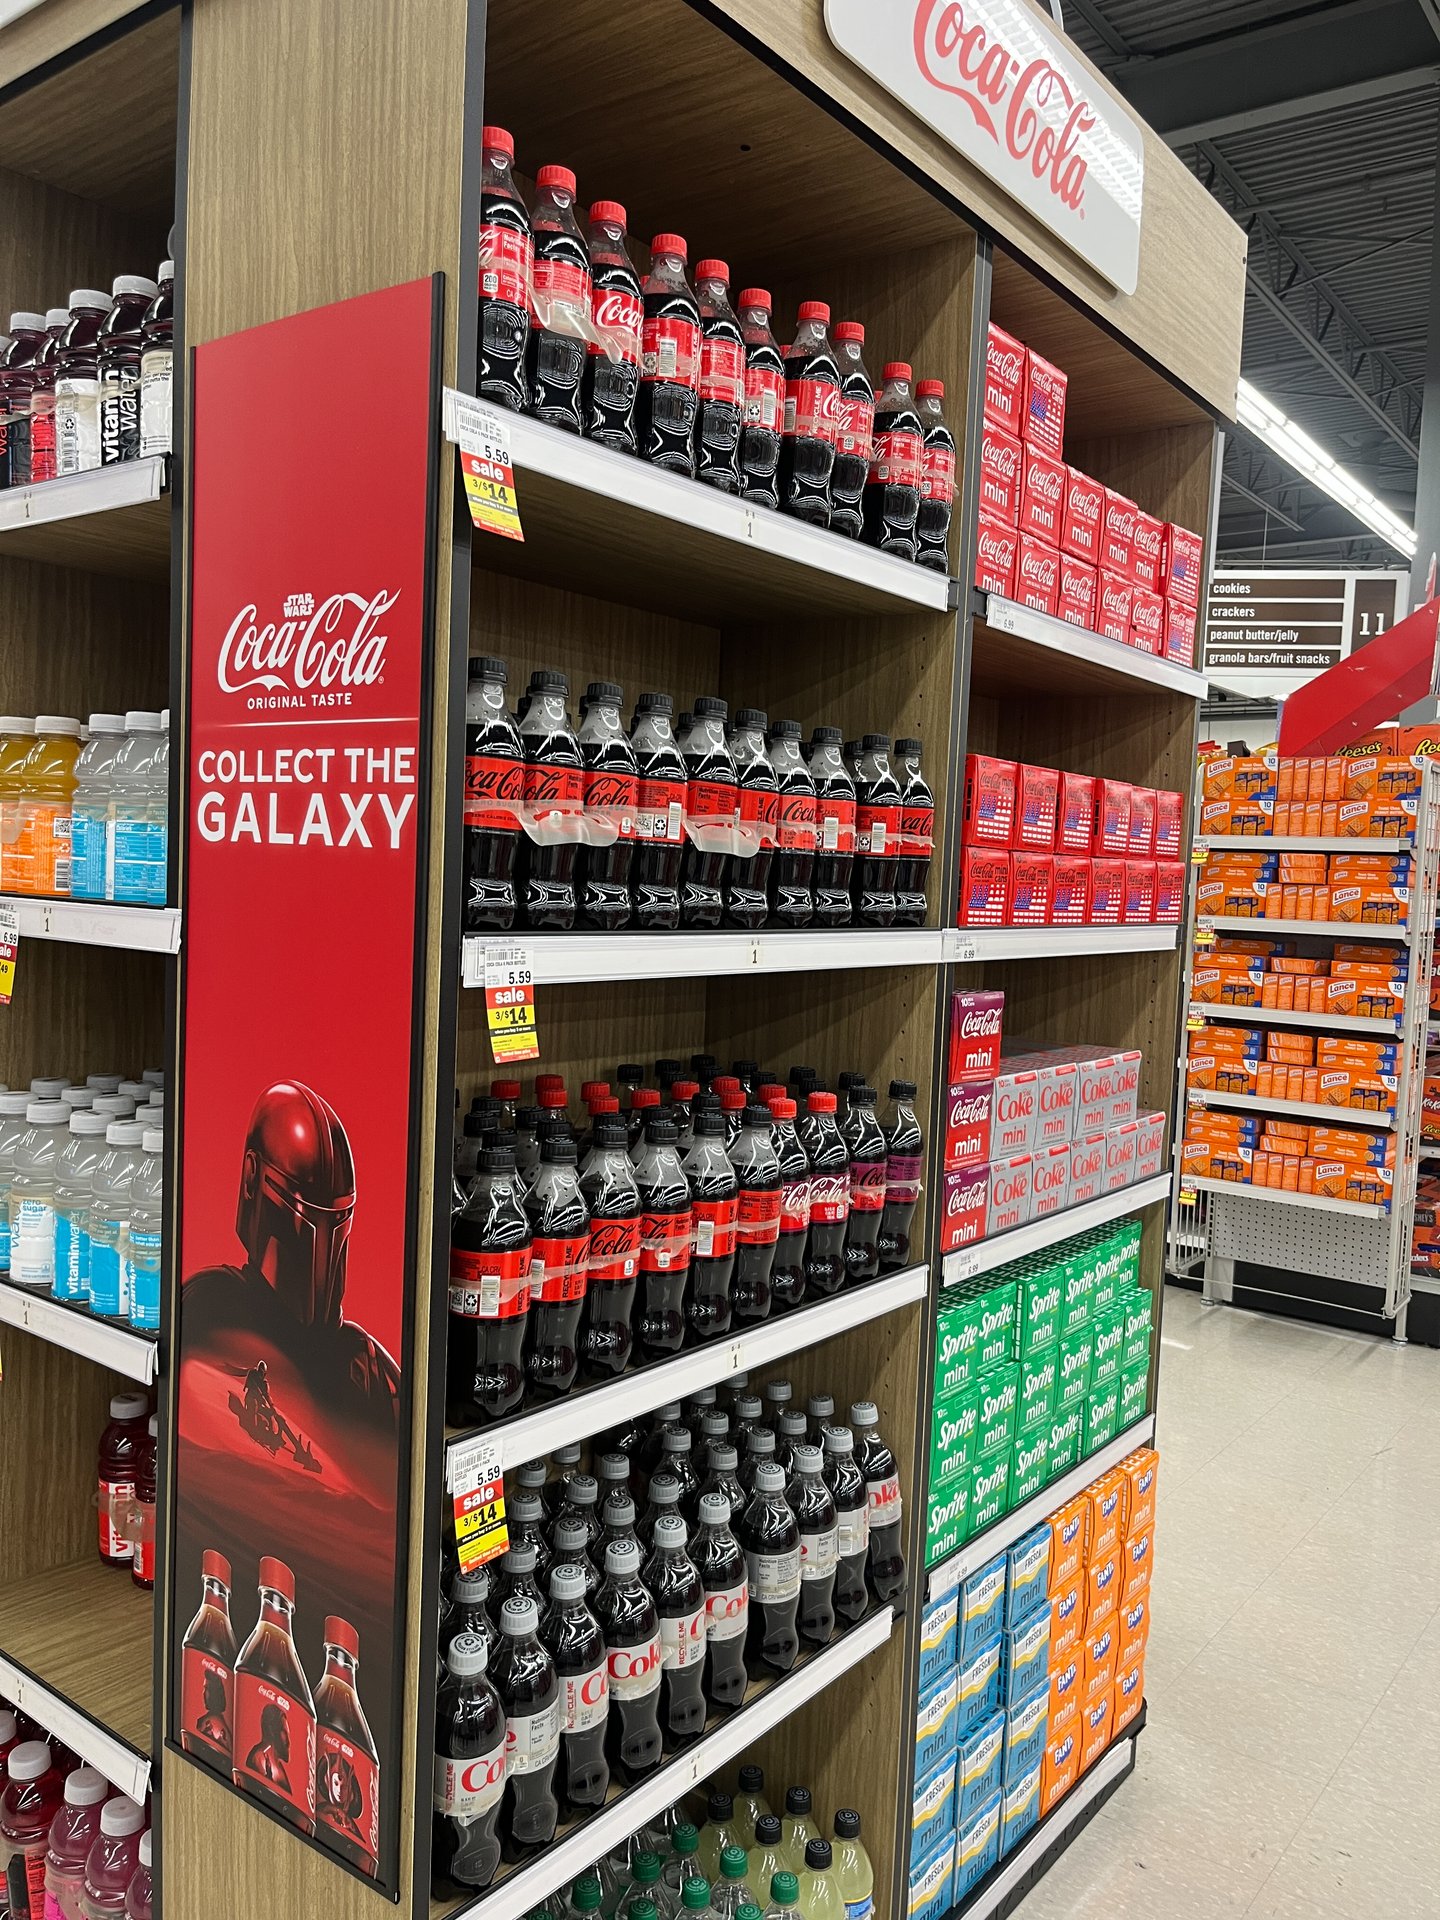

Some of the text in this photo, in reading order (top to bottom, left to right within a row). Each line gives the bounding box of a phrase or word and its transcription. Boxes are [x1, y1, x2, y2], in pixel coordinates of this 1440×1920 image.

[913, 0, 1097, 210] Coca-Cola
[986, 341, 1021, 384] Coca-Cola
[988, 385, 1011, 414] mini
[485, 445, 509, 465] 5.59
[981, 437, 1018, 477] Coca-Cola
[471, 459, 504, 481] sale
[1028, 463, 1063, 500] Coca-Cola
[985, 481, 1008, 507] mini
[1070, 486, 1101, 520] Coca-Cola
[1032, 504, 1054, 529] mini
[1072, 525, 1092, 548] mini
[978, 531, 1014, 568] Coca-Cola
[1109, 543, 1128, 564] mini
[1022, 552, 1057, 586] Coca-Cola
[1136, 559, 1154, 580] mini
[982, 574, 1005, 596] mini
[1062, 570, 1092, 602] Coca-Cola
[1213, 583, 1251, 594] cookies
[284, 604, 314, 618] WARS
[286, 593, 314, 606] STAR
[1026, 592, 1048, 612] mini
[1212, 606, 1255, 617] crackers
[1004, 619, 1014, 629] 6.99
[1210, 629, 1298, 642] peanut butter/jelly
[1360, 613, 1385, 635] 11
[217, 587, 402, 693] Coca-Cola
[1209, 653, 1330, 664] granola bars/fruit snacks
[247, 693, 352, 709] ORIGINAL TASTE
[199, 748, 415, 783] COLLECT THE
[1209, 761, 1232, 772] Lance
[1348, 761, 1375, 773] Lance
[198, 791, 415, 849] GALAXY
[1205, 803, 1228, 815] Lance
[1341, 803, 1367, 816] Lance
[995, 866, 1008, 874] mini
[1334, 889, 1360, 901] Lance
[4, 932, 17, 944] 6.99
[964, 950, 974, 959] 6.99
[509, 971, 531, 984] 5.59
[495, 987, 525, 1004] sale
[961, 998, 968, 1007] 10
[961, 1008, 1003, 1038] Coca-Cola
[966, 1047, 992, 1068] mini
[1082, 1077, 1111, 1104] Coke
[1111, 1069, 1137, 1094] Coke
[1322, 1075, 1348, 1085] Lance
[998, 1093, 1033, 1122] Coke
[1041, 1084, 1073, 1112] Coke
[1112, 1098, 1131, 1115] mini
[951, 1094, 992, 1128] Coca-Cola
[1085, 1107, 1104, 1126] mini
[1002, 1125, 1026, 1145] mini
[1044, 1115, 1065, 1135] mini
[955, 1133, 981, 1156] mini
[1108, 1141, 1133, 1168] Coke
[1138, 1131, 1161, 1156] Coke
[1072, 1152, 1101, 1180] Coke
[1317, 1166, 1343, 1176] Lance
[948, 1176, 954, 1185] 10
[993, 1175, 1027, 1206] Coke
[1034, 1165, 1065, 1193] Coke
[1075, 1183, 1093, 1200] mini
[948, 1180, 988, 1216] Coca-Cola
[1038, 1192, 1058, 1213] mini
[997, 1206, 1019, 1228] mini
[952, 1219, 977, 1244] mini
[68, 1211, 80, 1294] vitaminwater
[1029, 1287, 1060, 1322] Sprite
[979, 1302, 1013, 1340] Sprite
[1032, 1318, 1052, 1344] mini
[1125, 1308, 1150, 1338] Sprite
[940, 1324, 978, 1365] Sprite
[983, 1335, 1005, 1361] mini
[1128, 1336, 1144, 1358] mini
[944, 1359, 968, 1387] mini
[938, 1408, 976, 1450] Sprite
[941, 1444, 966, 1475] mini
[477, 1466, 500, 1486] 5.59
[973, 1463, 1008, 1504] Sprite
[464, 1487, 494, 1511] sale
[976, 1496, 998, 1526] mini
[928, 1490, 967, 1535] Sprite
[932, 1526, 957, 1559] mini
[1097, 1526, 1115, 1549] mini
[1025, 1548, 1041, 1569] FRESCA
[1058, 1549, 1077, 1578] mini
[978, 1578, 996, 1600] FRESCA
[1020, 1578, 1040, 1608] mini
[679, 1621, 684, 1632] ME
[928, 1610, 947, 1634] FRESCA
[974, 1608, 995, 1640] mini
[923, 1641, 947, 1676] mini
[925, 1779, 945, 1806] FRESCA
[1016, 1778, 1033, 1801] FRESCA
[1050, 1767, 1071, 1799] mini
[920, 1809, 945, 1847] mini
[1011, 1805, 1032, 1840] mini
